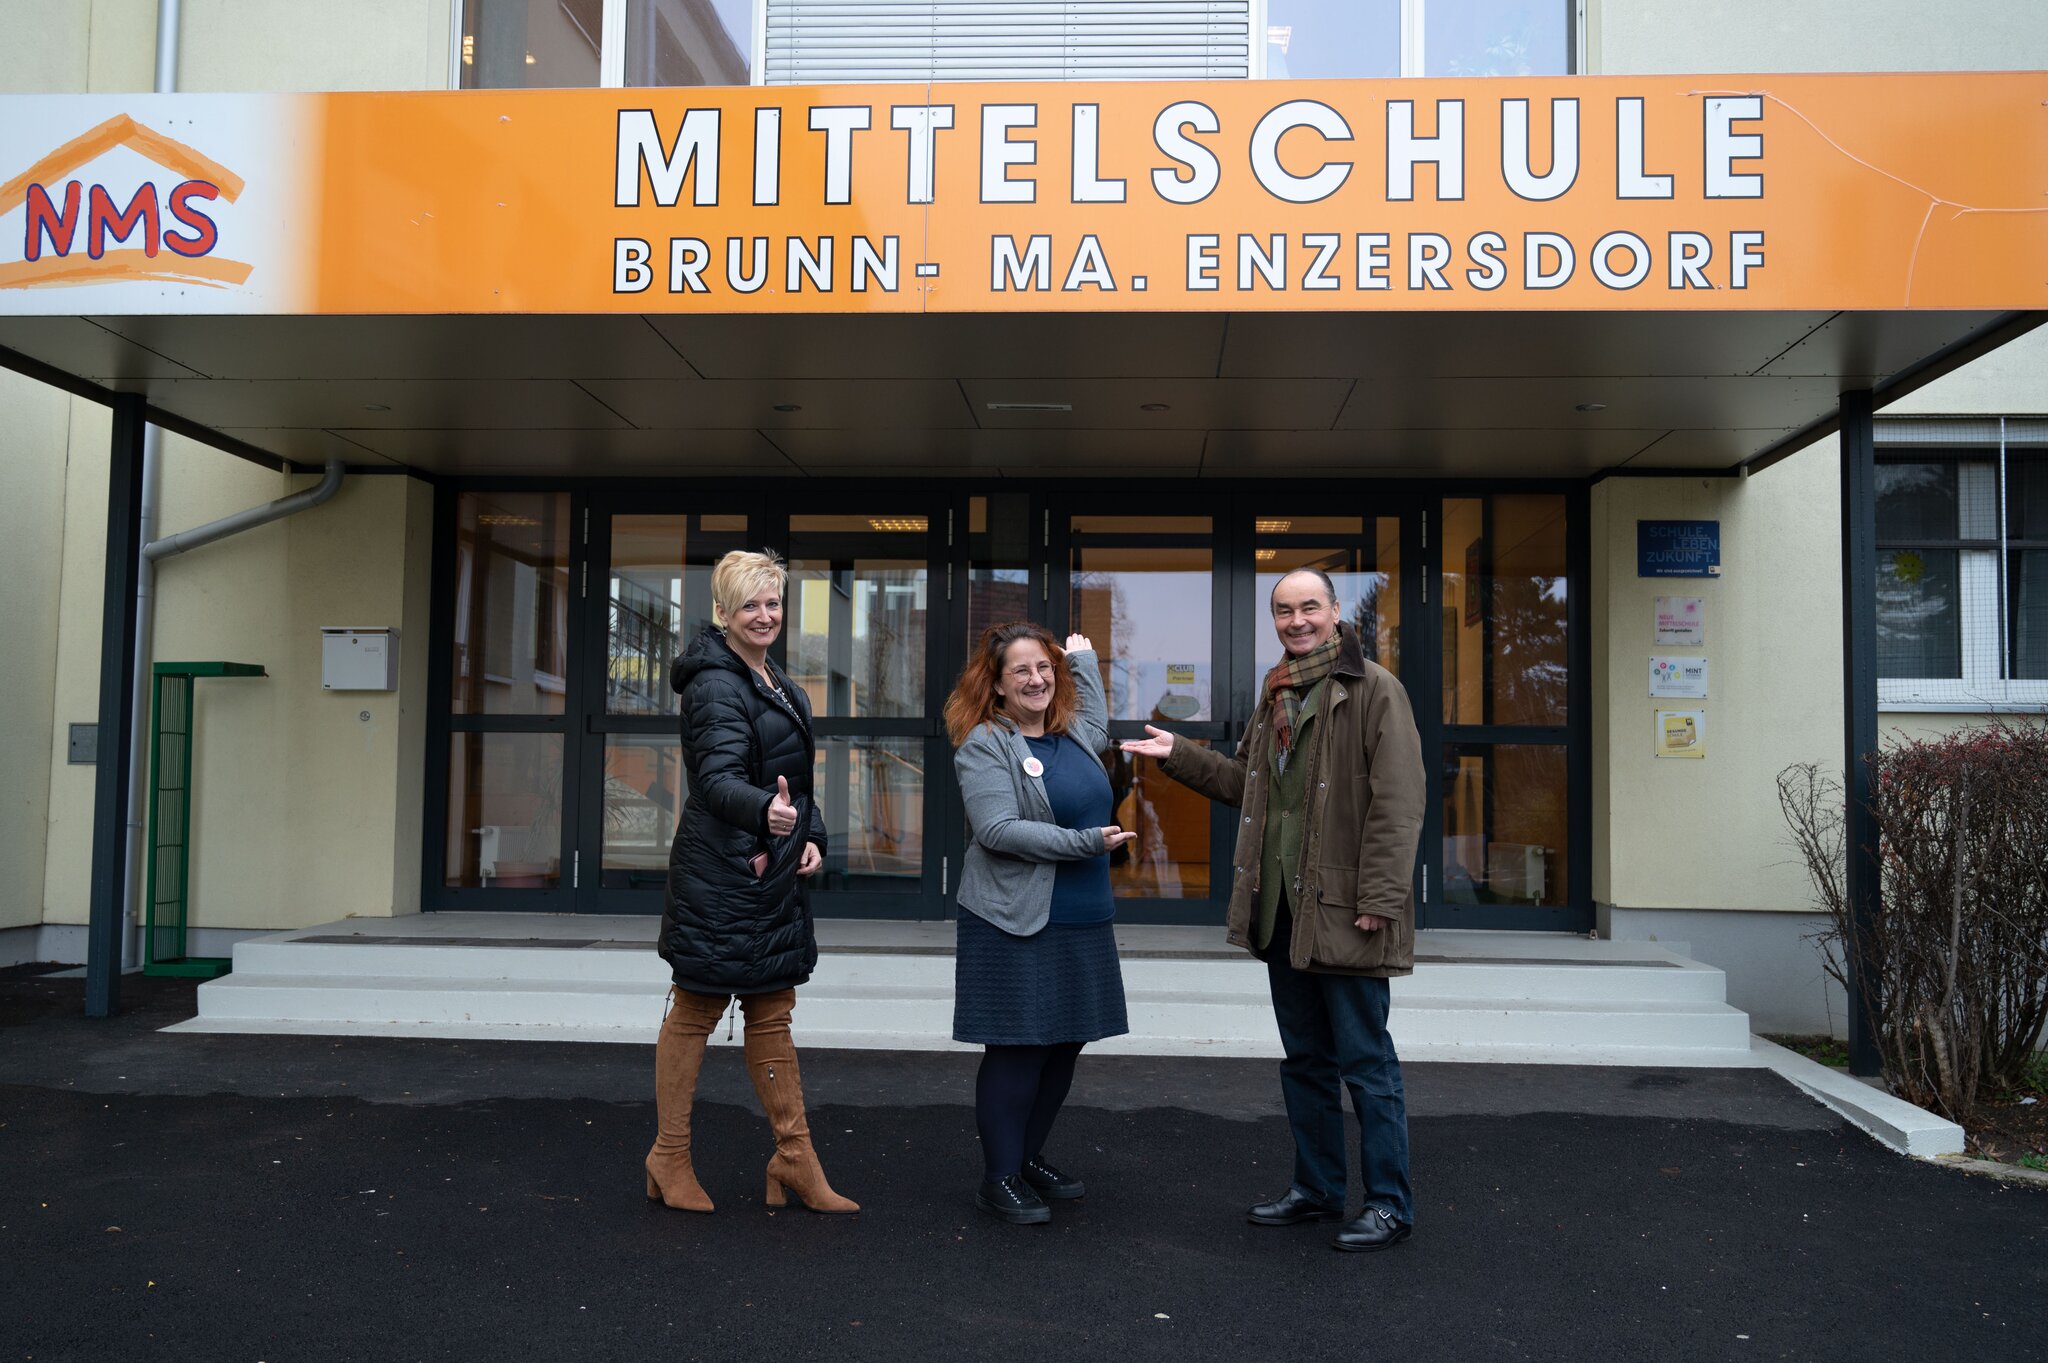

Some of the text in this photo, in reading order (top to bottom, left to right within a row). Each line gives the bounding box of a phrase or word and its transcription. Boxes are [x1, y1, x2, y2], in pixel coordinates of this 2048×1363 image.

[614, 95, 1765, 208] MITTELSCHULE
[24, 180, 219, 262] NMS
[612, 230, 1766, 294] BRUNN- MA. ENZERSDORF
[1646, 551, 1714, 563] ZUKUNFT.
[1649, 526, 1708, 537] SCHULE.
